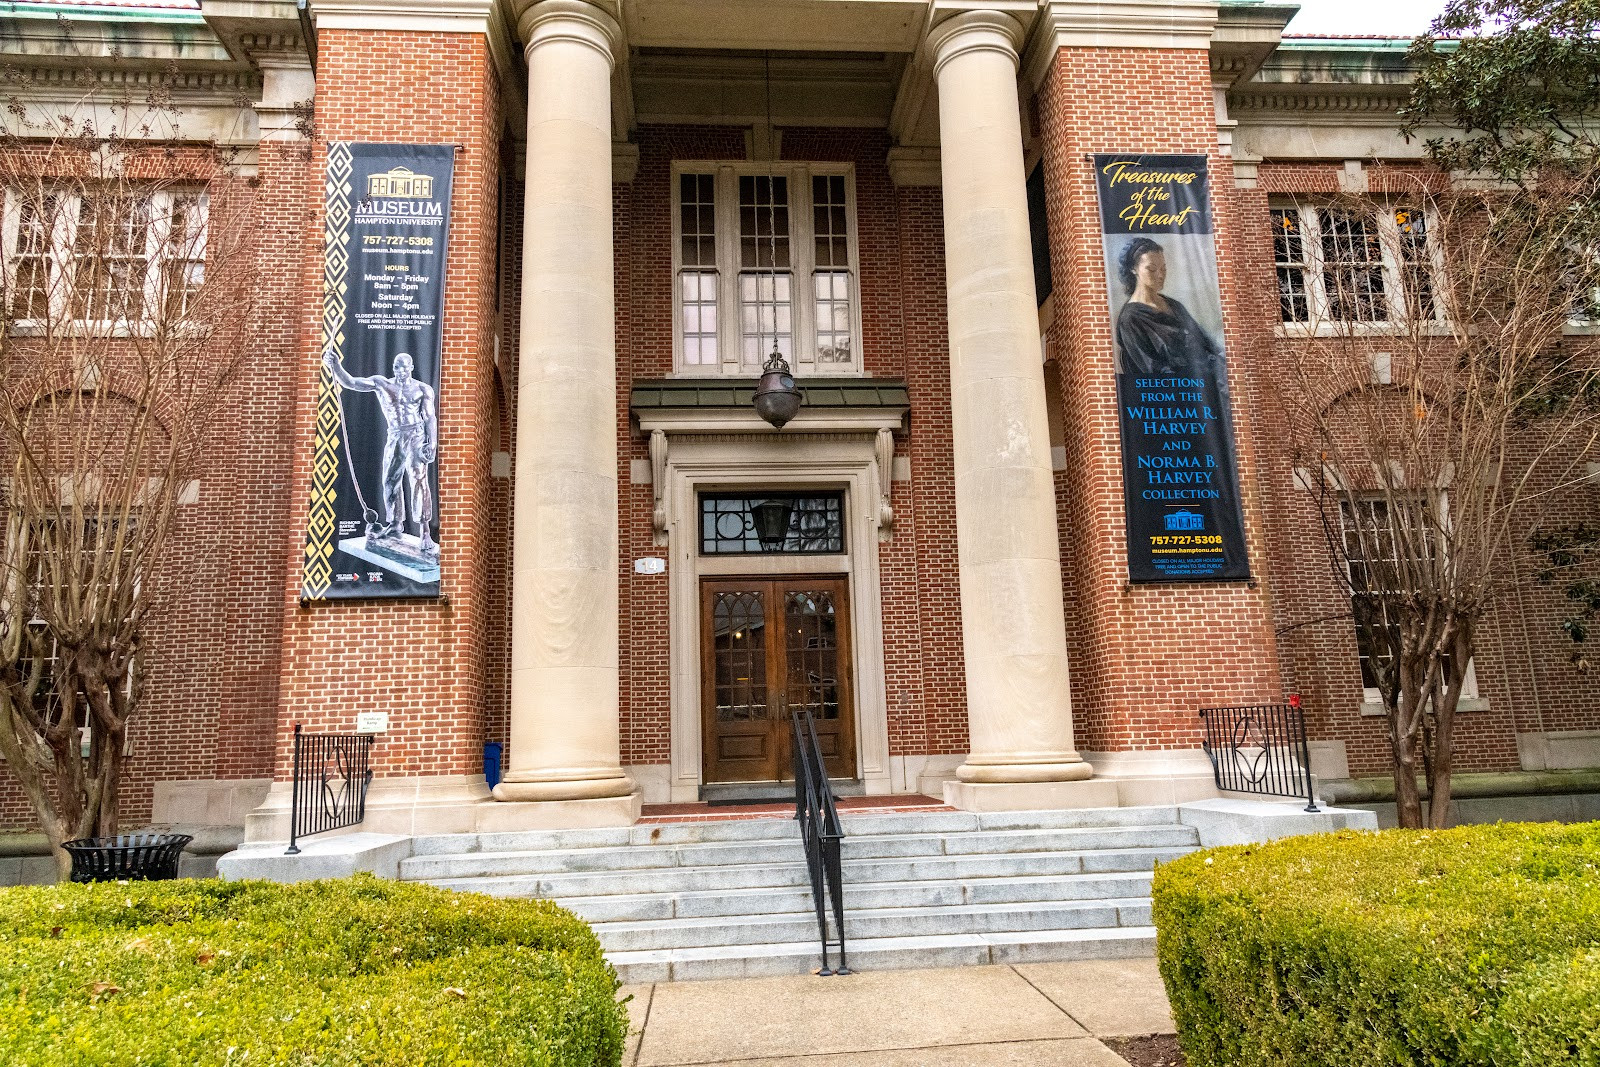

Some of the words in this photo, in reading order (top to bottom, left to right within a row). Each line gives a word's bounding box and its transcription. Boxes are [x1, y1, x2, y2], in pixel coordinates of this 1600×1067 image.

[1102, 161, 1198, 187] Treasures
[1130, 187, 1147, 208] of
[1148, 187, 1170, 200] the
[355, 200, 443, 216] MUSEUM
[1118, 204, 1200, 230] Heart
[362, 236, 433, 245] 757-727-5308
[364, 274, 395, 282] Monday
[405, 275, 429, 283] Friday
[401, 283, 418, 291] 5pm
[378, 294, 413, 302] Saturday
[1136, 378, 1205, 388] SELECTIONS
[1141, 393, 1176, 402] FROM
[1179, 392, 1203, 402] THE
[1127, 407, 1198, 420] WILLIAM
[1203, 406, 1218, 419] R.
[1143, 422, 1207, 434] HARVEY
[1162, 441, 1191, 450] AND
[1138, 455, 1202, 468] NORMA
[1205, 455, 1218, 468] B.
[1148, 471, 1213, 484] HARVEY
[1142, 490, 1219, 499] COLLECTION
[1150, 536, 1222, 544] 757-727-5308
[642, 560, 657, 570] 14
